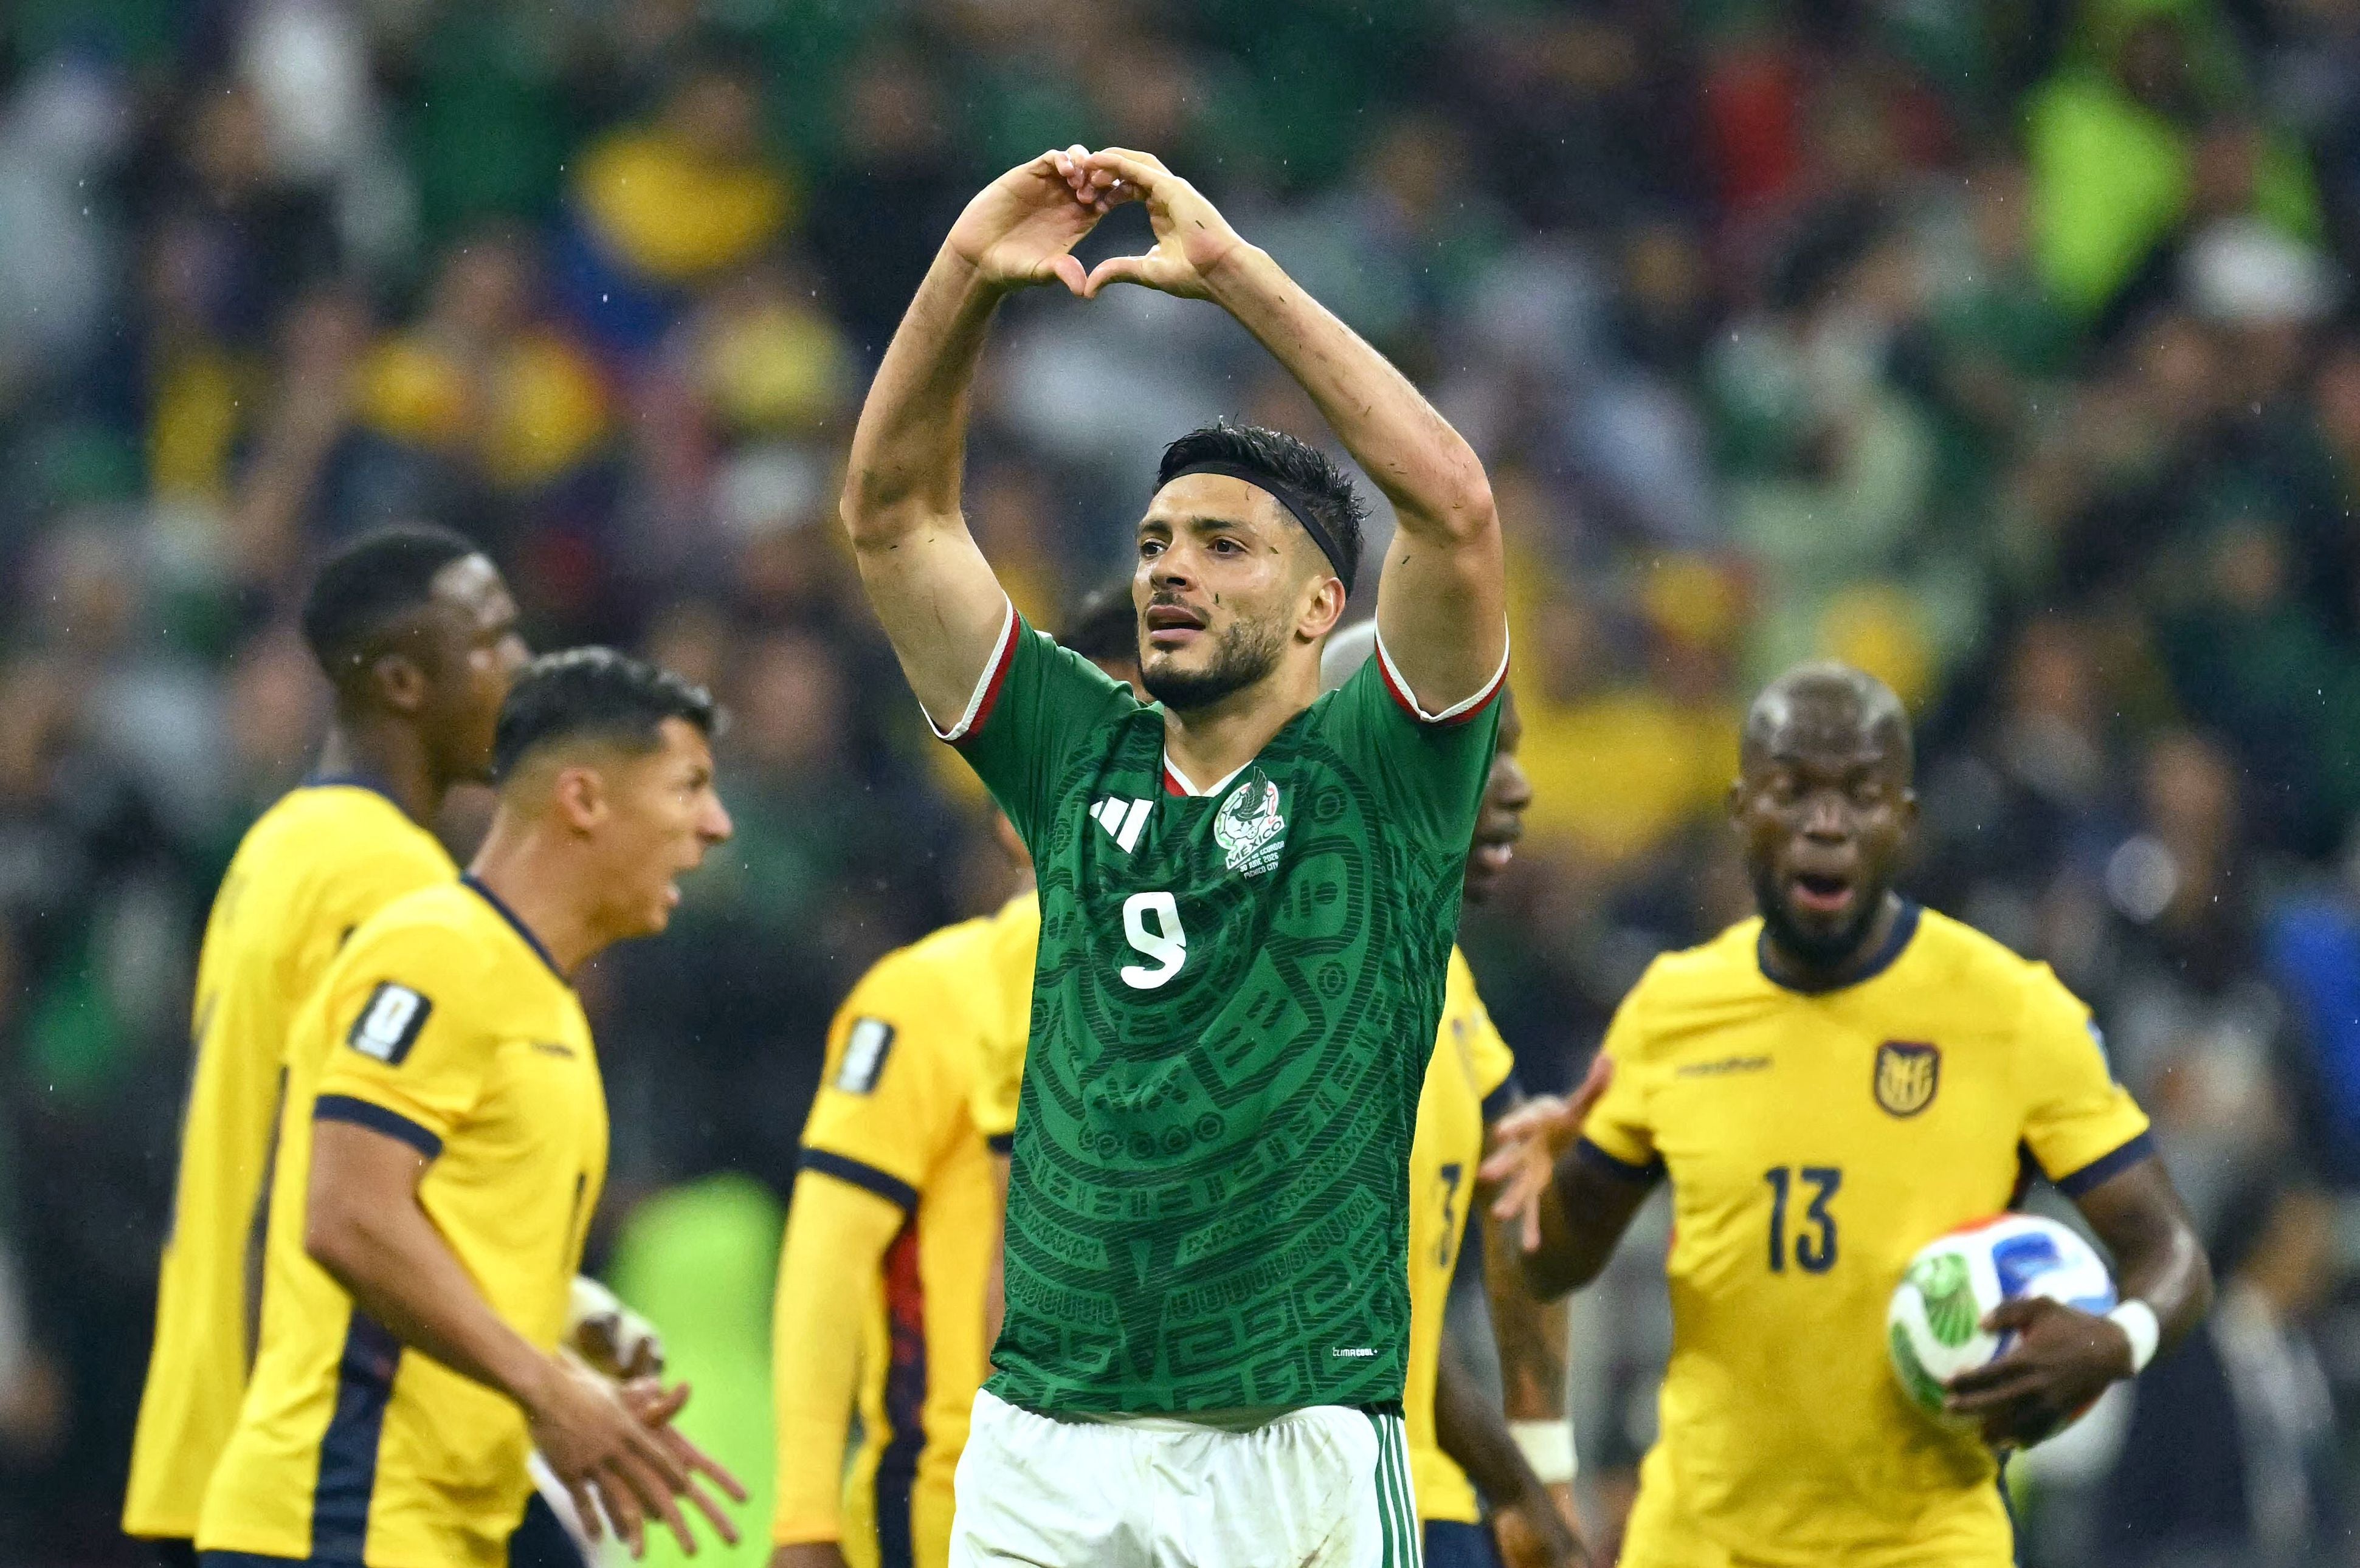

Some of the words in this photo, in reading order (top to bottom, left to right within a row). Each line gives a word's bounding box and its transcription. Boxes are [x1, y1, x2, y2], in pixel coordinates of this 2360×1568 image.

[1240, 864, 1248, 872] 30
[1249, 858, 1263, 869] JUNE
[1263, 852, 1279, 863] 2026
[1266, 861, 1278, 871] CITY
[1120, 892, 1187, 989] 9
[1764, 1165, 1842, 1275] 13
